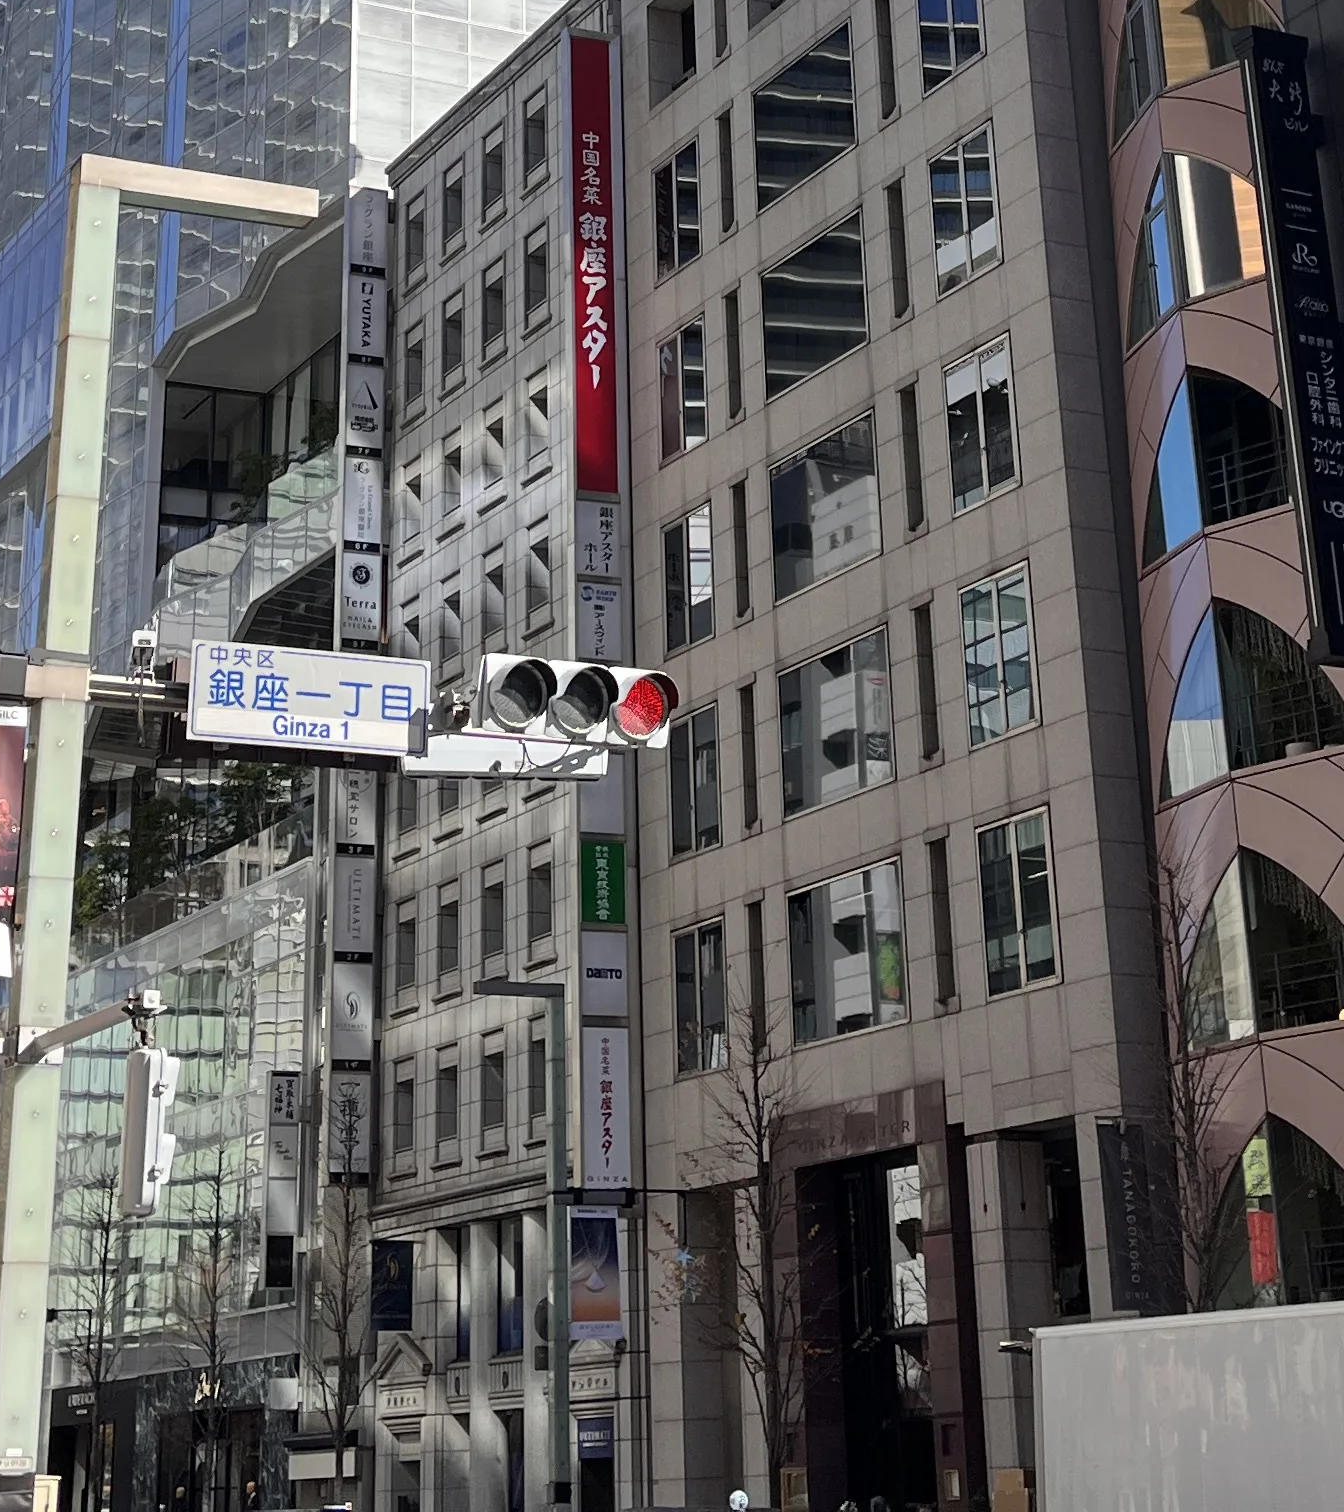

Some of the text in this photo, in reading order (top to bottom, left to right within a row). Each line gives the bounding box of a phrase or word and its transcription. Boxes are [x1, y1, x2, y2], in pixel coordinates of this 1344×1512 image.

[1283, 117, 1309, 133] ビル
[579, 130, 603, 206] 中国名菜
[361, 299, 372, 348] YUTAKA
[578, 211, 608, 390] 銀座アスター
[583, 542, 598, 572] ホール
[599, 506, 615, 574] 銀座アスター
[344, 595, 377, 610] Terra
[209, 645, 276, 670] 中央区
[207, 668, 413, 723] 銀座一丁目
[272, 714, 350, 740] Ginza 1
[351, 868, 362, 942] ULTIMATE
[346, 953, 360, 961] 2F
[599, 1079, 613, 1169] 銀座アスター
[586, 1175, 629, 1183] GINZA
[1121, 1168, 1141, 1284] TANAGOKORO
